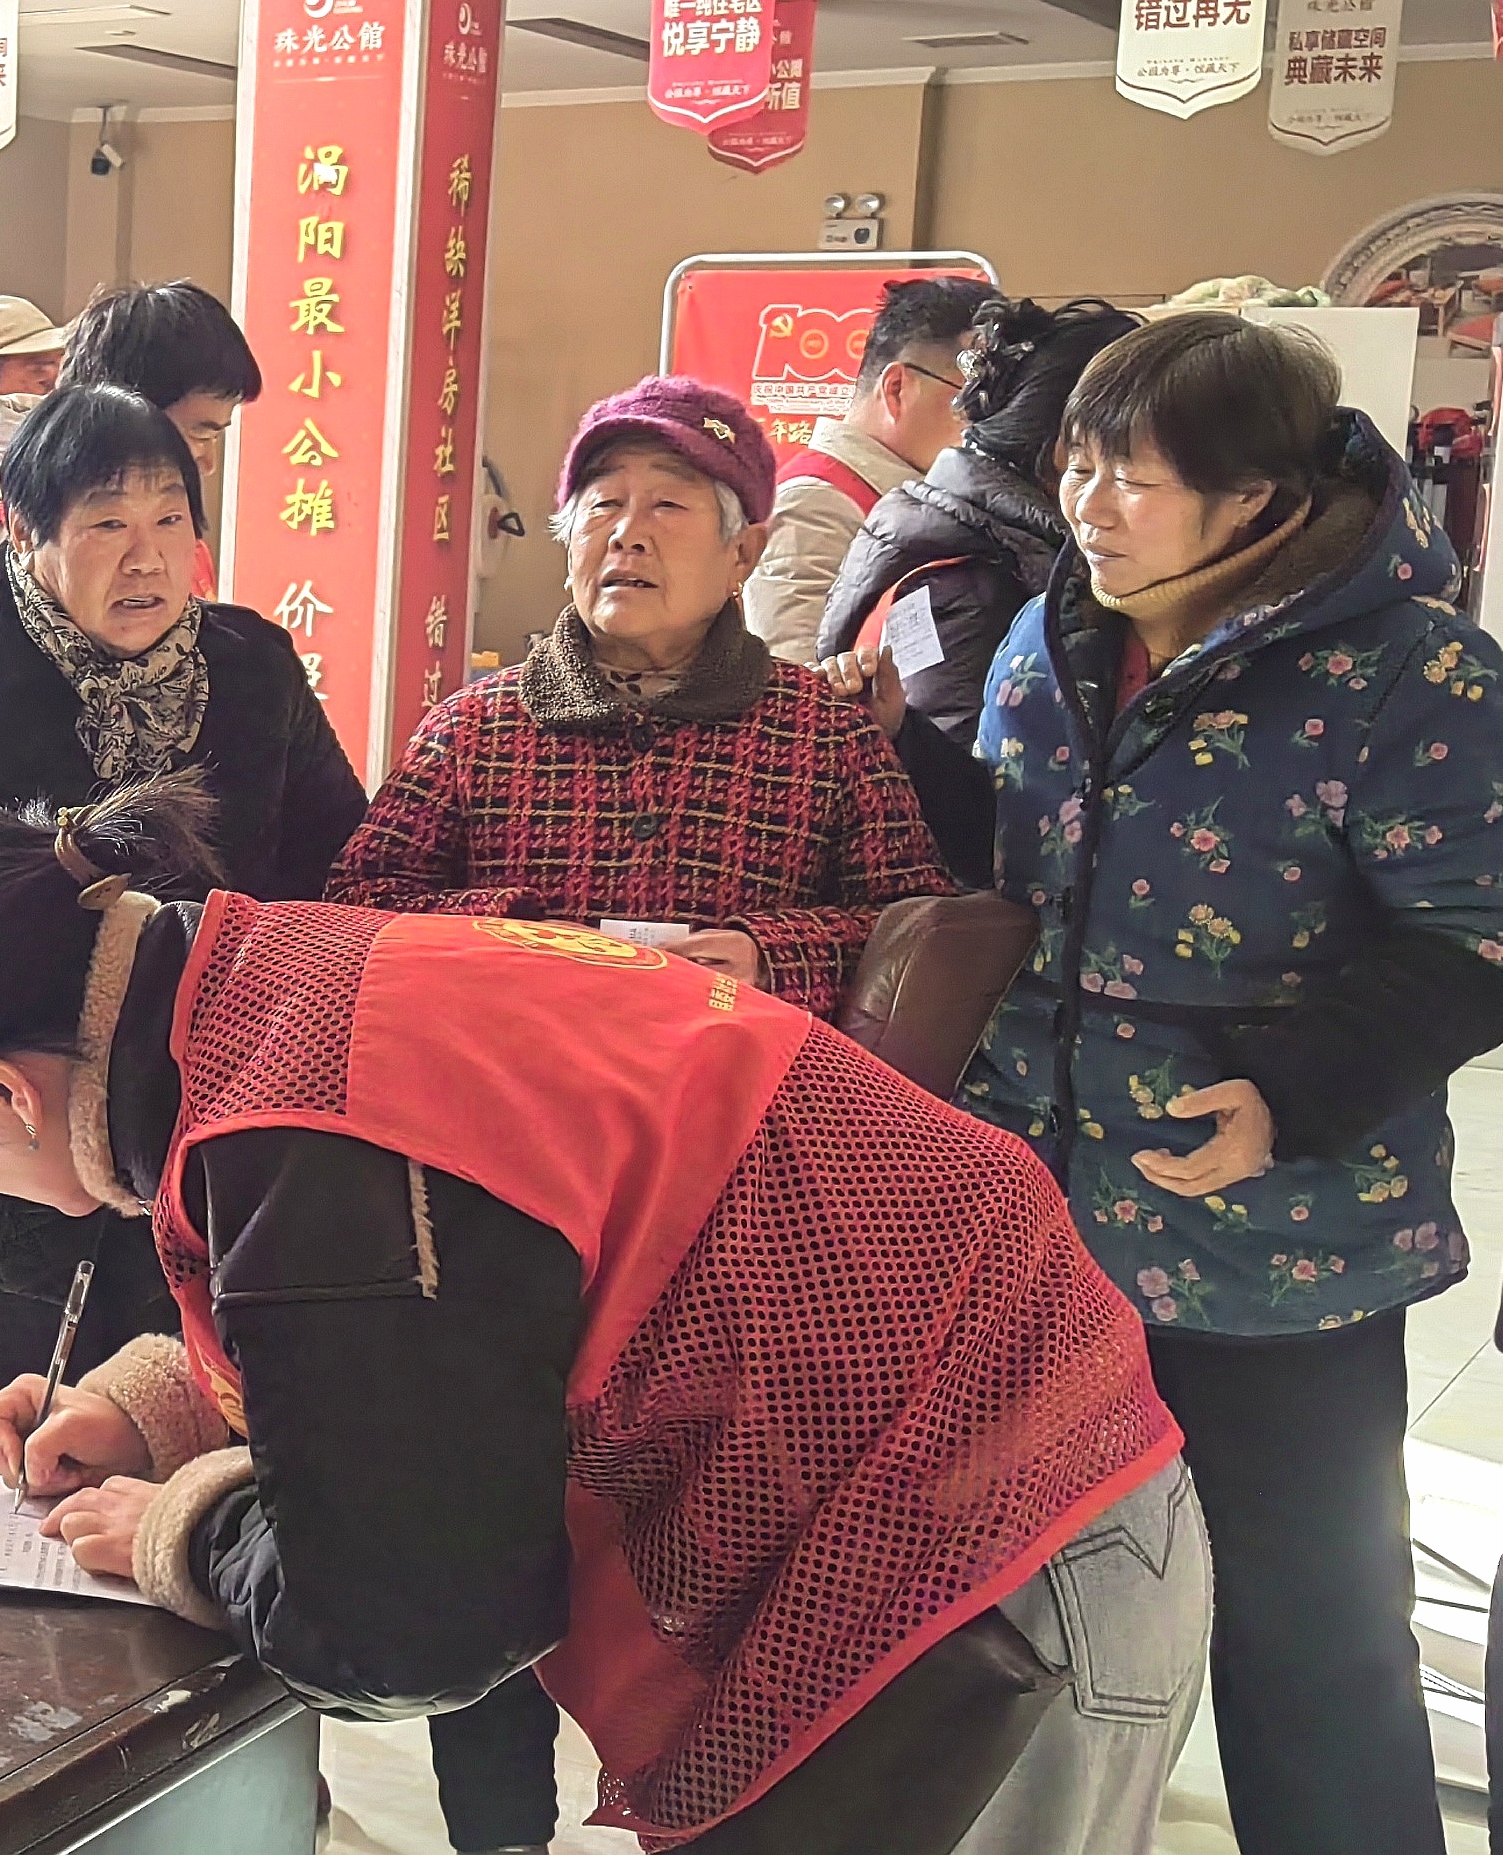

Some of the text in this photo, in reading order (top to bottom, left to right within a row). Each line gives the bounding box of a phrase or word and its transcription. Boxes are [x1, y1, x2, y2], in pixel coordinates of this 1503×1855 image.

[662, 16, 760, 57] 悦享宁静
[1289, 27, 1387, 52] 私享储藏空间
[1284, 52, 1384, 86] 典藏未来
[753, 384, 855, 397] 庆祝中国共产党成立
[756, 417, 813, 445] 年路
